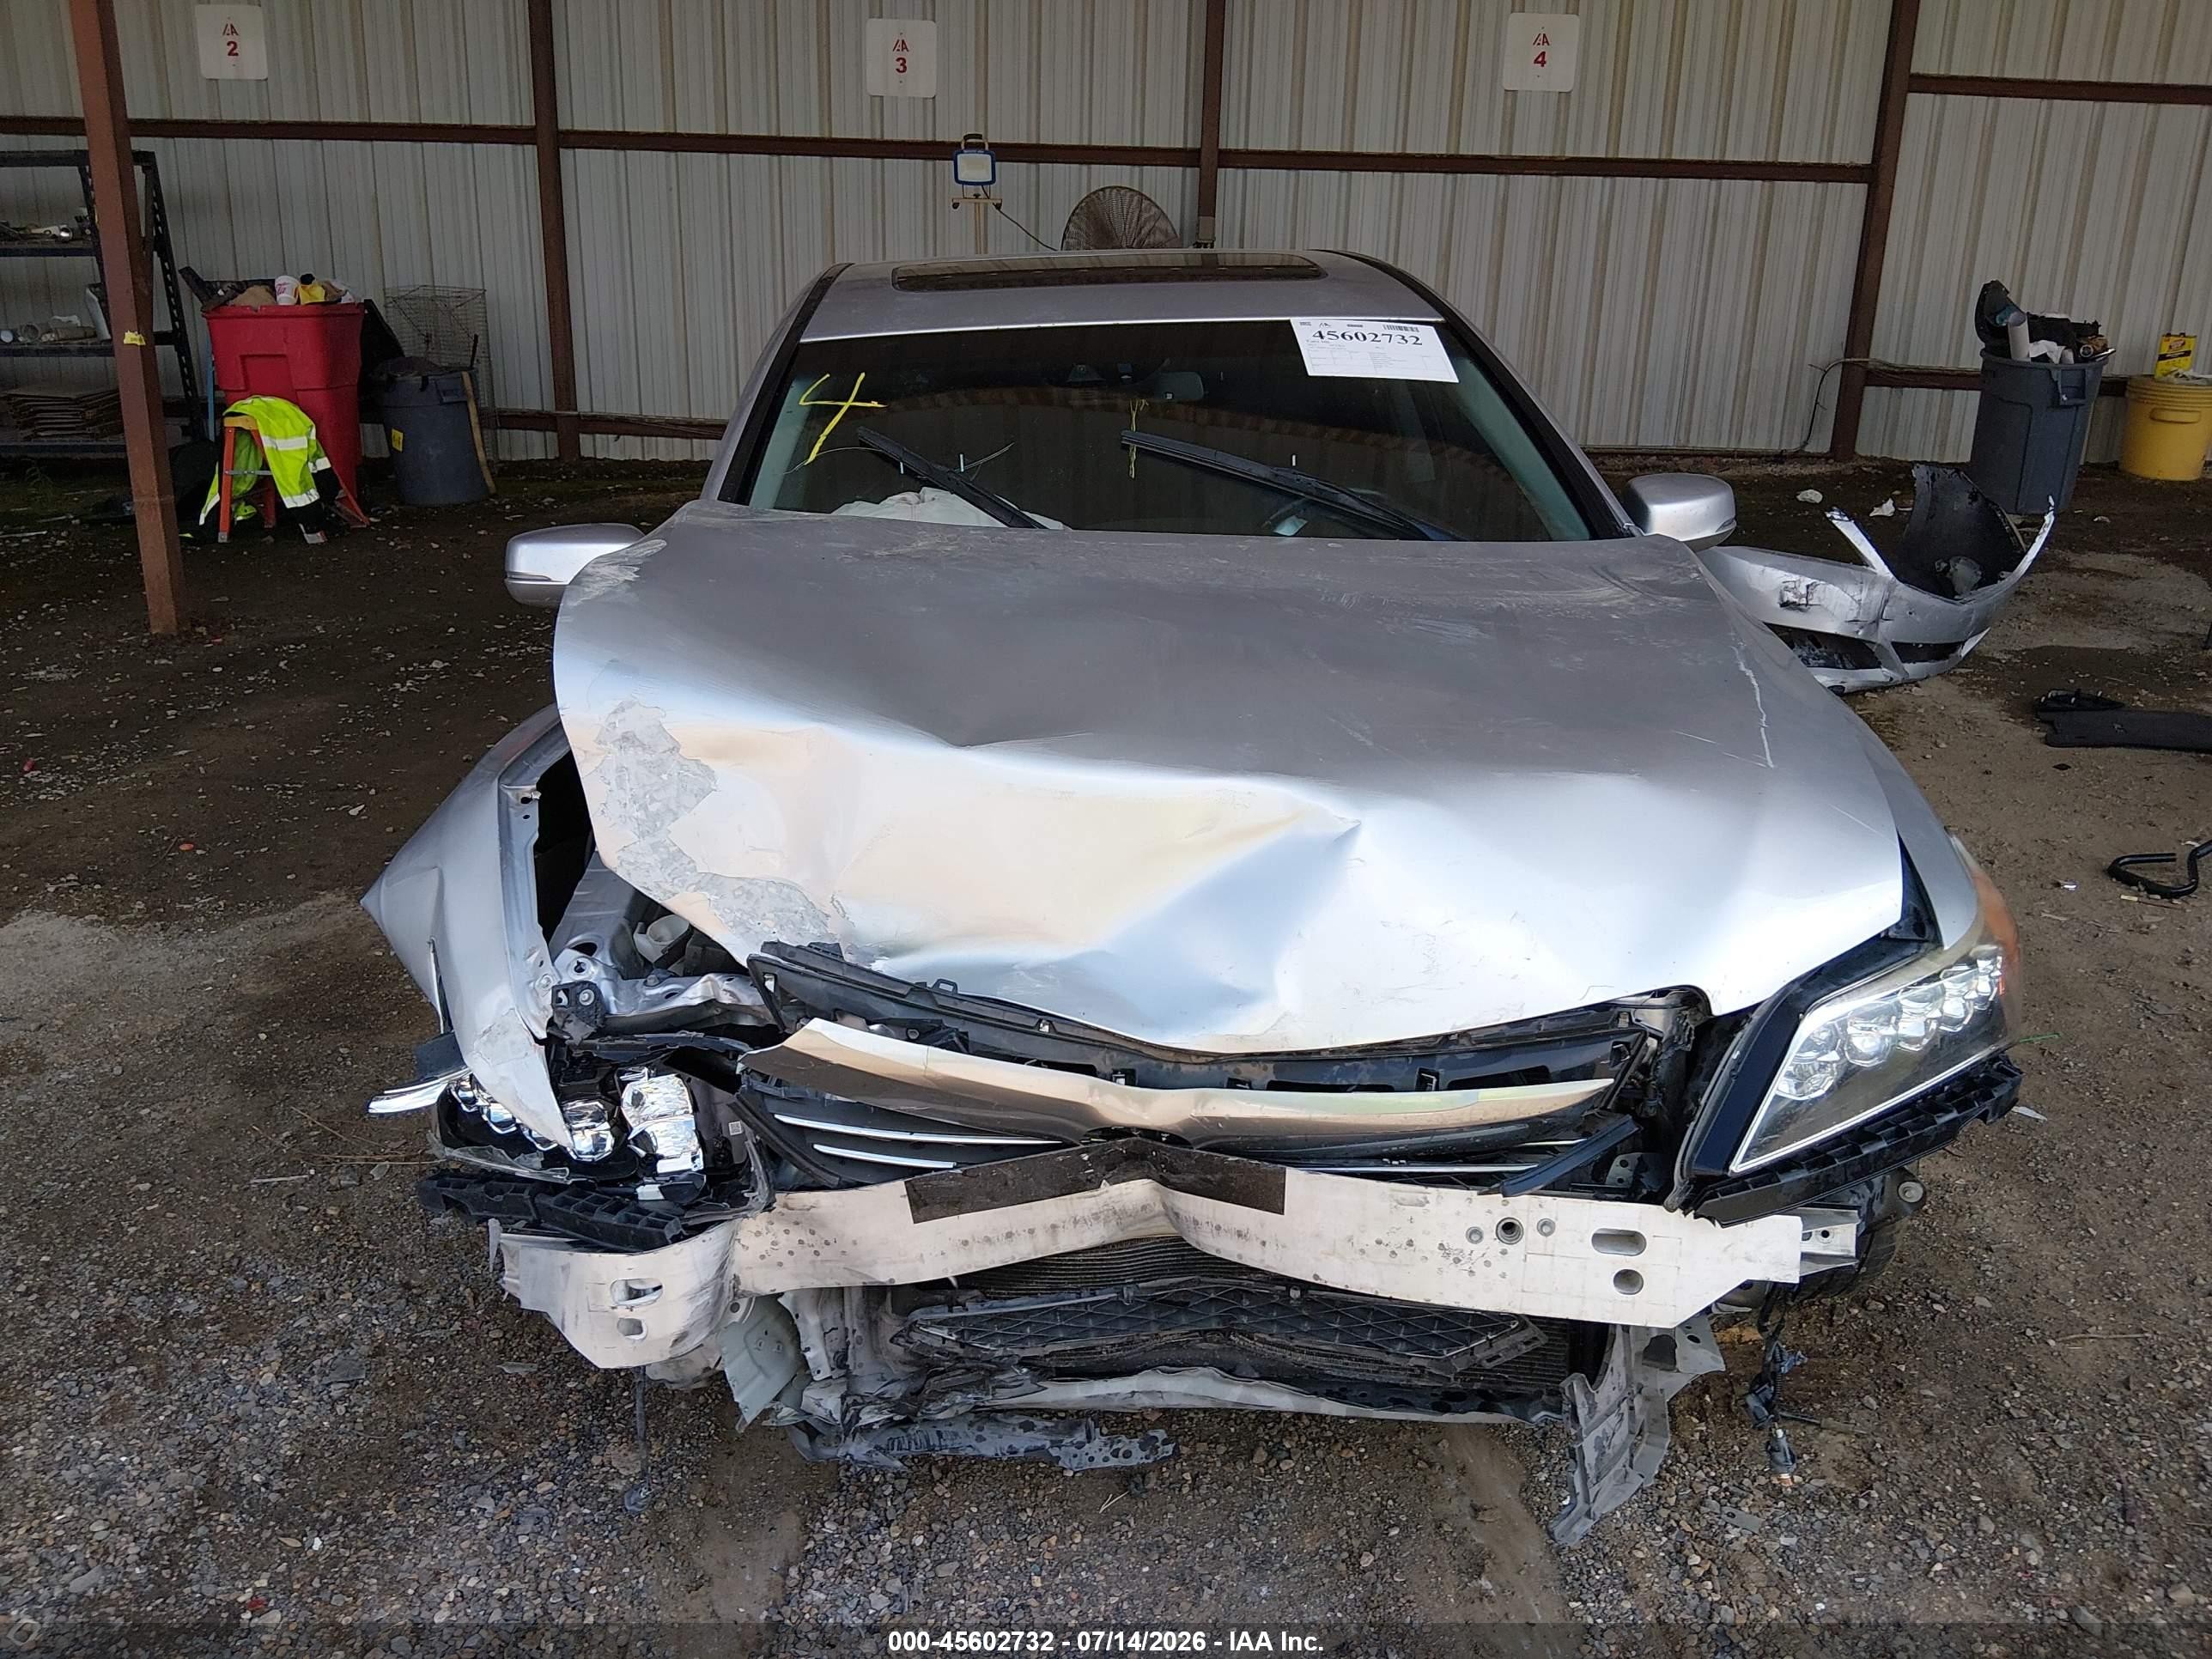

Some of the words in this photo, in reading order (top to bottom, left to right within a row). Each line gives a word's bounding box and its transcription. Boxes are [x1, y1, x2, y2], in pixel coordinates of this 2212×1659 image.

[226, 40, 239, 57] 2
[895, 57, 908, 74] 3
[1533, 51, 1547, 68] 4
[1311, 330, 1423, 346] 45602732
